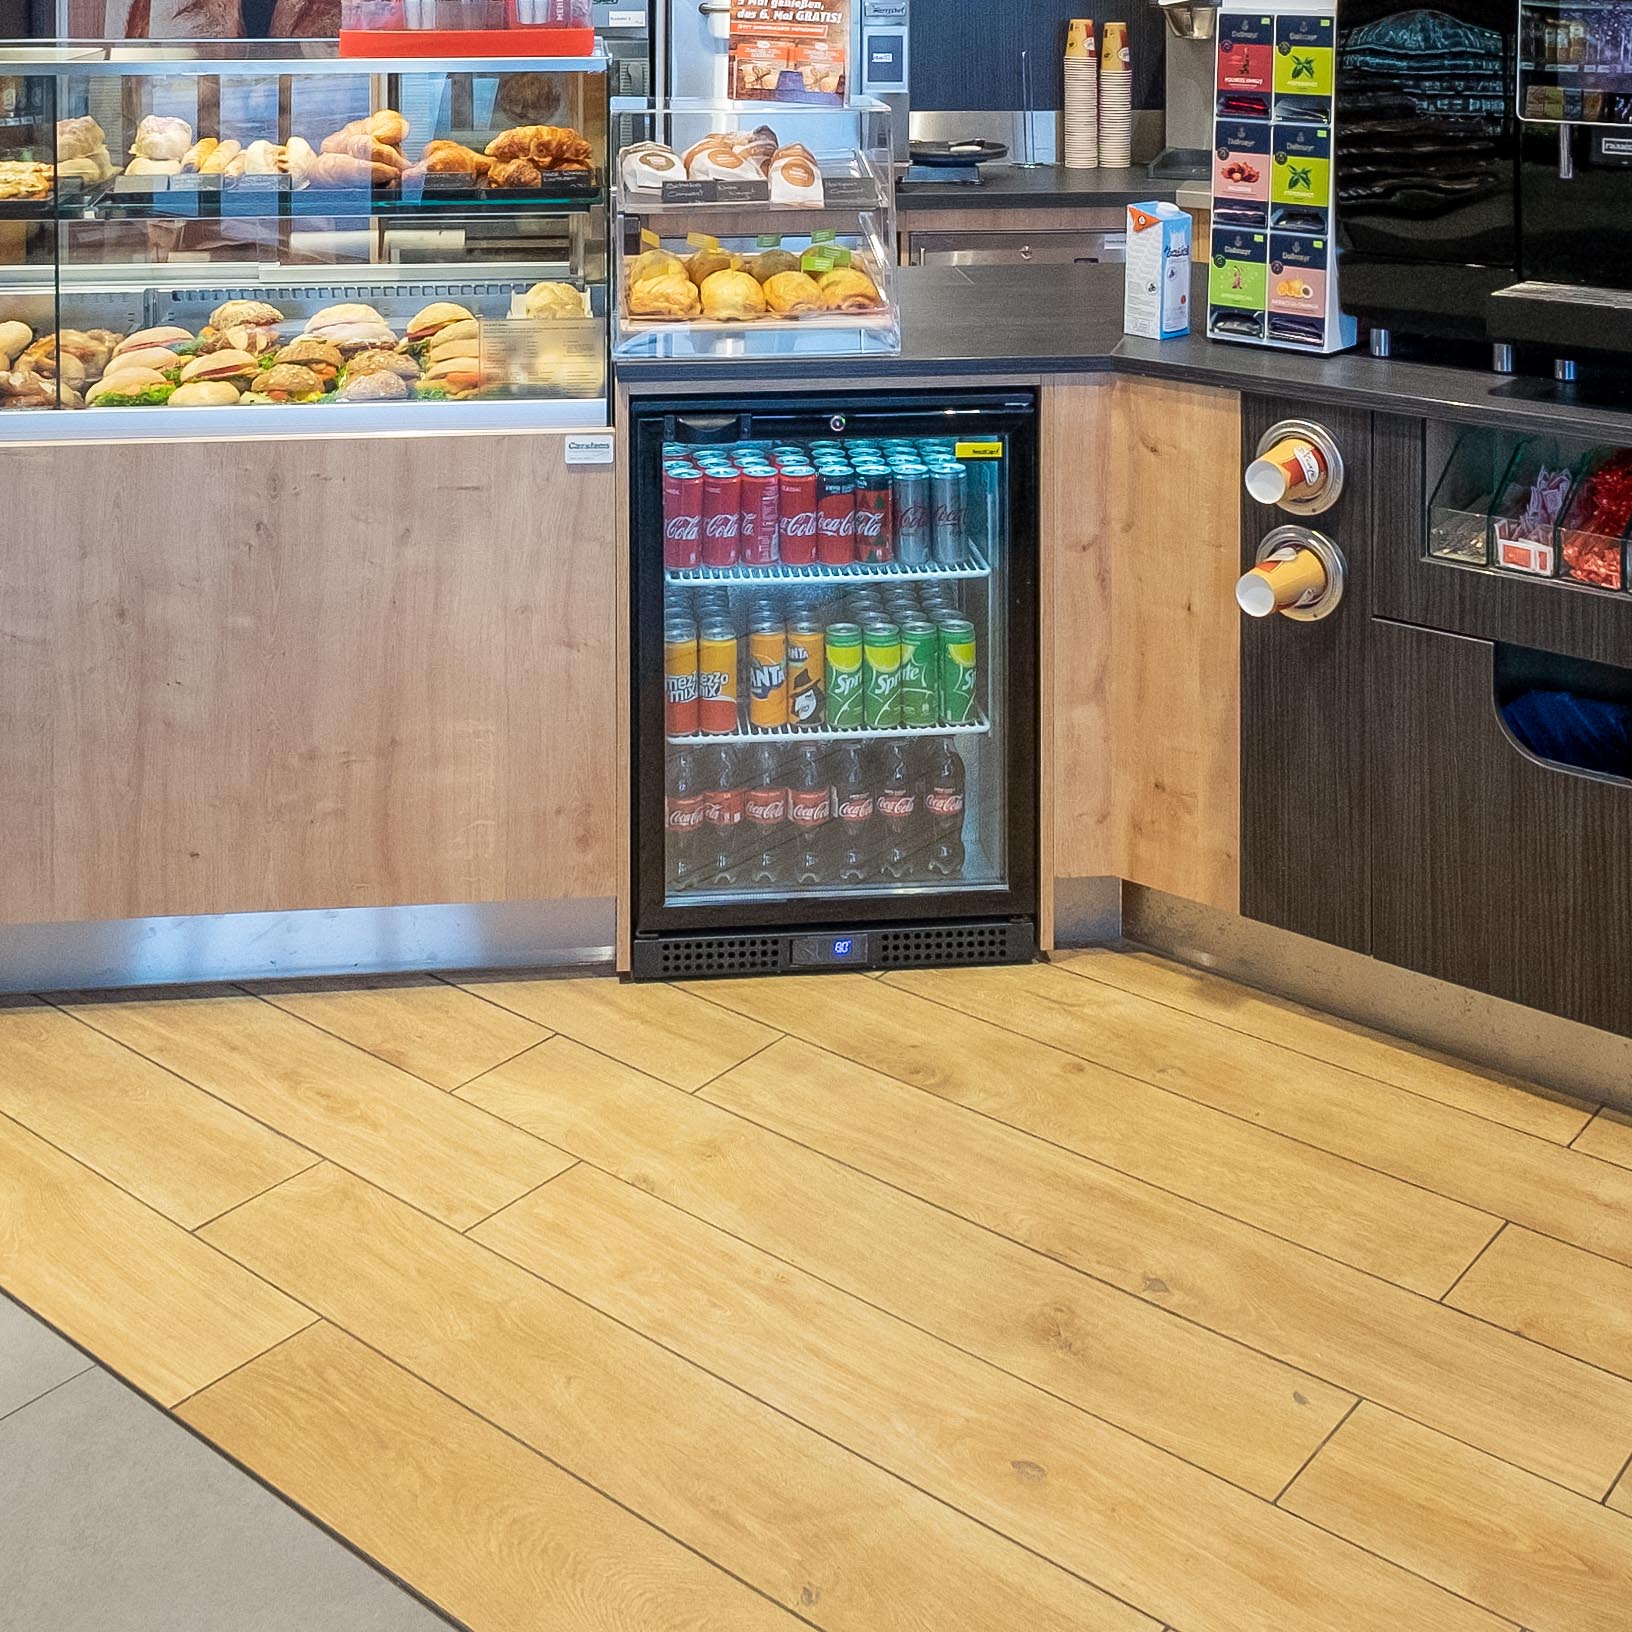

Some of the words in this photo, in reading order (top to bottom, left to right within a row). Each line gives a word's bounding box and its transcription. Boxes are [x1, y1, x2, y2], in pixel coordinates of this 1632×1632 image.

[737, 9, 757, 19] das
[773, 10, 793, 21] Mal
[795, 11, 843, 24] GRATIS!
[667, 515, 700, 540] Cola
[706, 513, 739, 537] Cola
